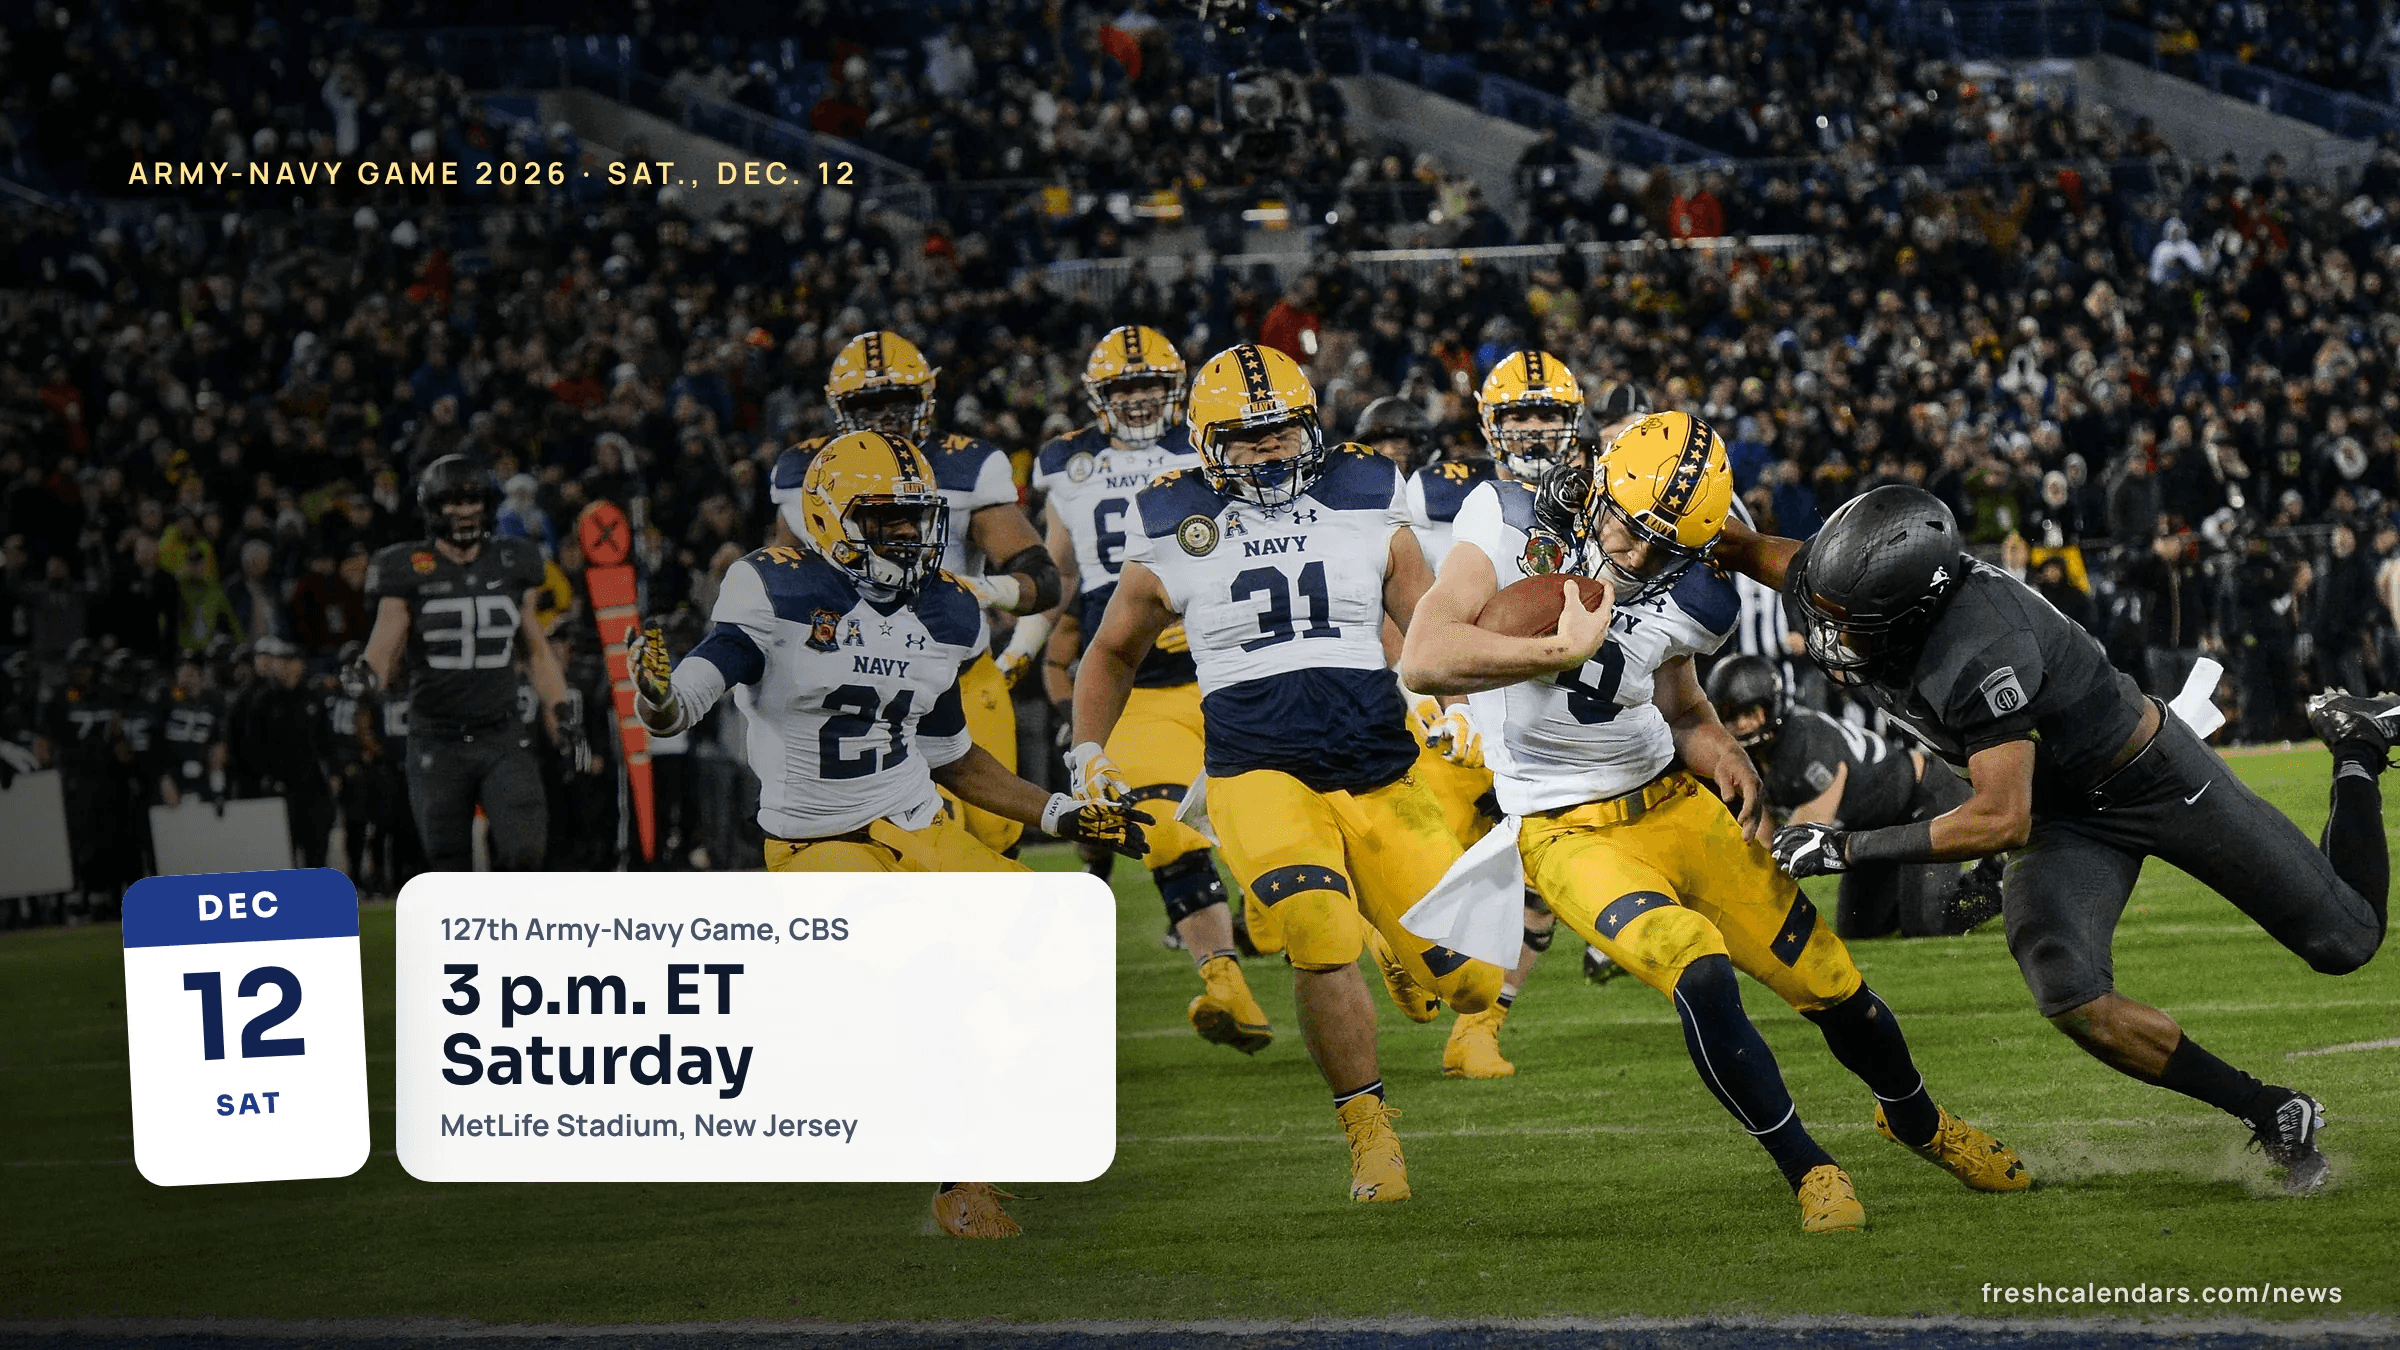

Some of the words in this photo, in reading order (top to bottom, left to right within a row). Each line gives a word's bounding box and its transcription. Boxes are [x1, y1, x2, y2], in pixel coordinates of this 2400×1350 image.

[1106, 474, 1150, 489] NAVY
[1094, 498, 1130, 575] 6
[1242, 535, 1308, 558] NAVY
[1643, 513, 1675, 537] NAVY
[420, 594, 521, 670] 39
[1230, 561, 1342, 653] 31
[852, 655, 910, 679] NAVY
[818, 683, 915, 780] 21
